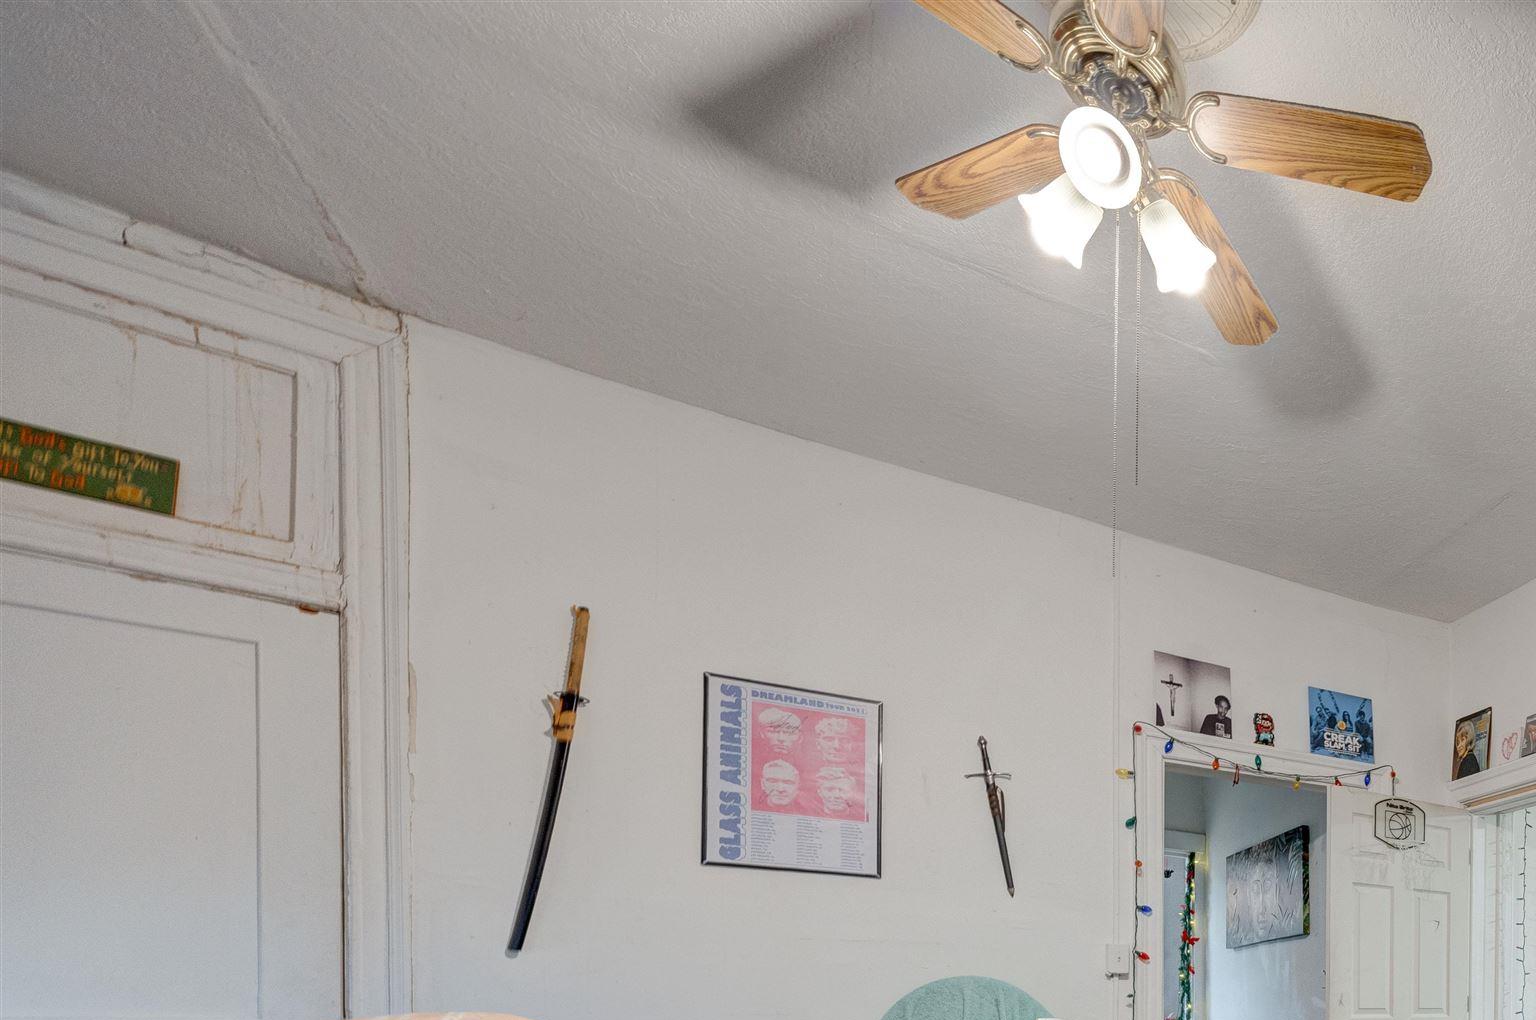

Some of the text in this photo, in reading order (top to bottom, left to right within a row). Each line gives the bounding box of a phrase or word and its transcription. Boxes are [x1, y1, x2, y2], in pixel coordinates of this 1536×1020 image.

[751, 689, 824, 708] DREAMLAND
[1324, 732, 1361, 746] CREAK
[718, 683, 745, 861] GLASS ANIMALS
